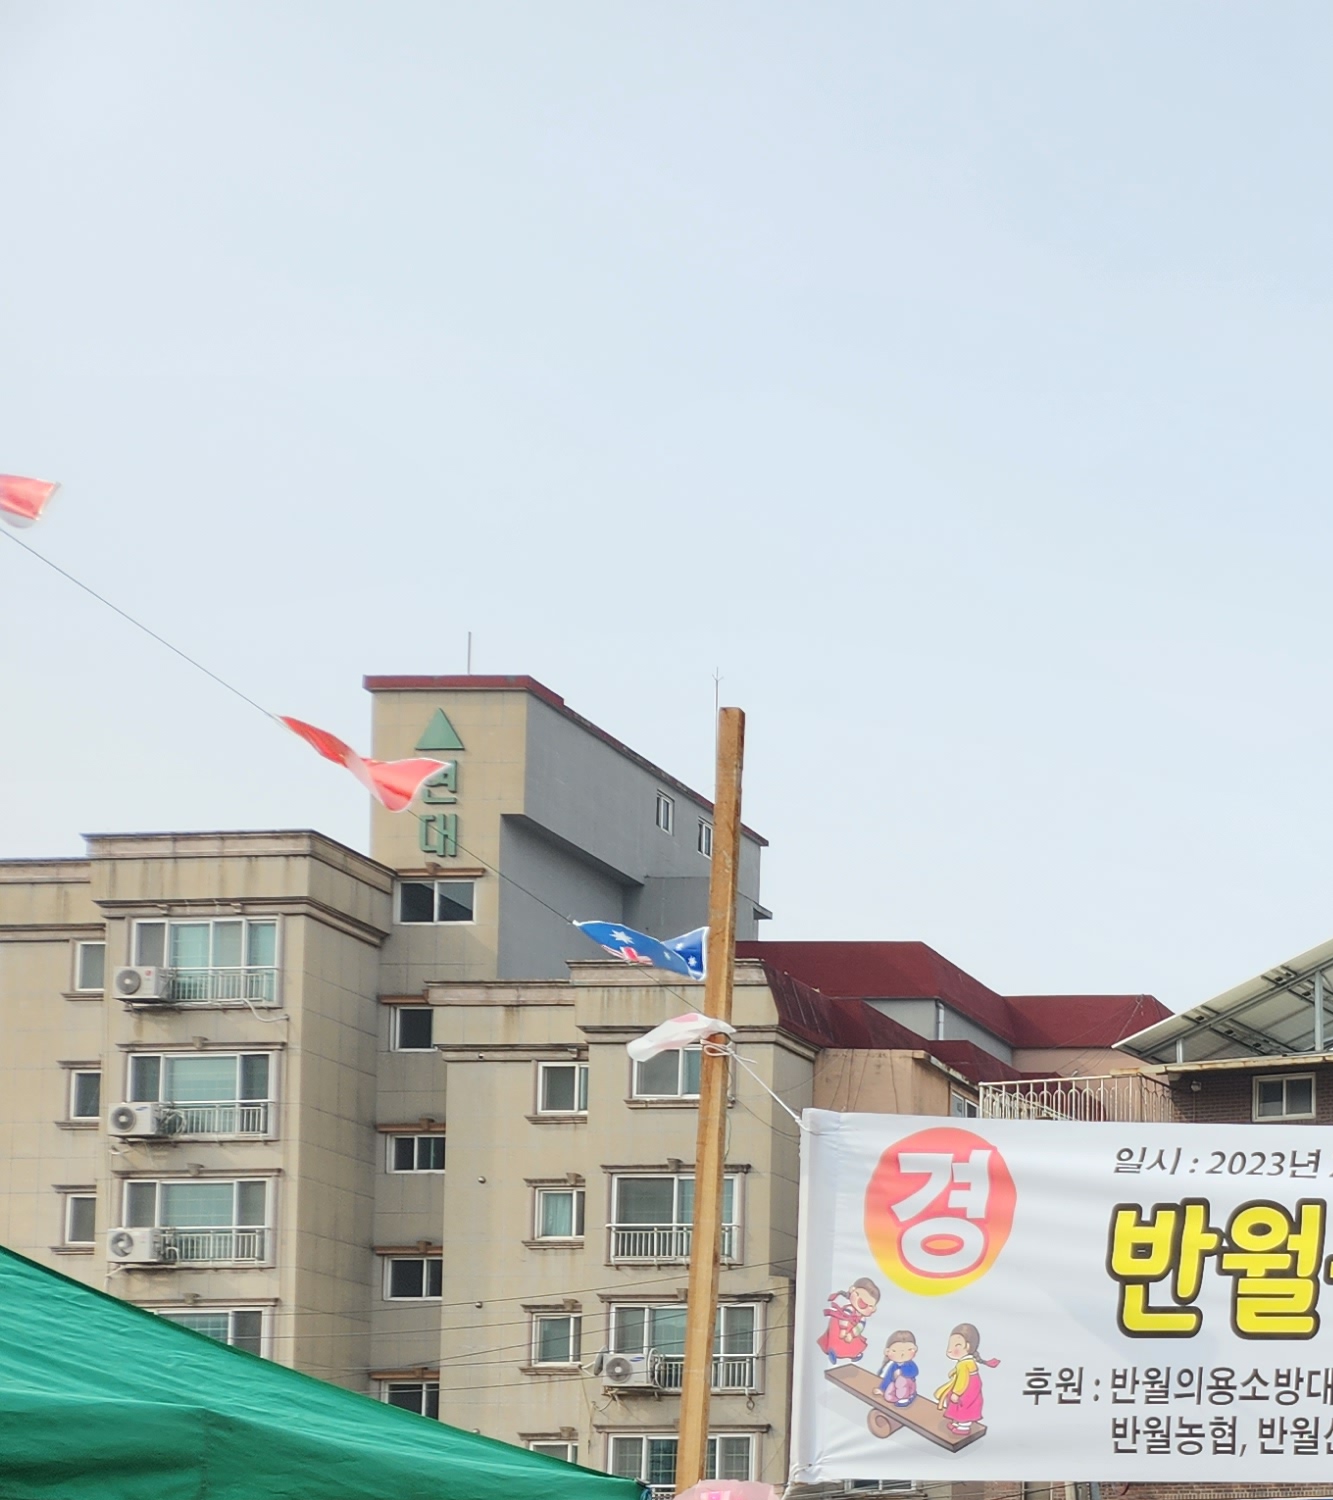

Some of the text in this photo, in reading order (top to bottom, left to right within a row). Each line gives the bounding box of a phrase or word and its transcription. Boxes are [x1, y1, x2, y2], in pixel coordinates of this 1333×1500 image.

[1114, 1147, 1180, 1178] 일시
[1208, 1149, 1319, 1180] 2023년
[886, 1148, 992, 1278] 경
[1021, 1368, 1086, 1407] 후원
[1110, 1416, 1247, 1458] 반월농협,
